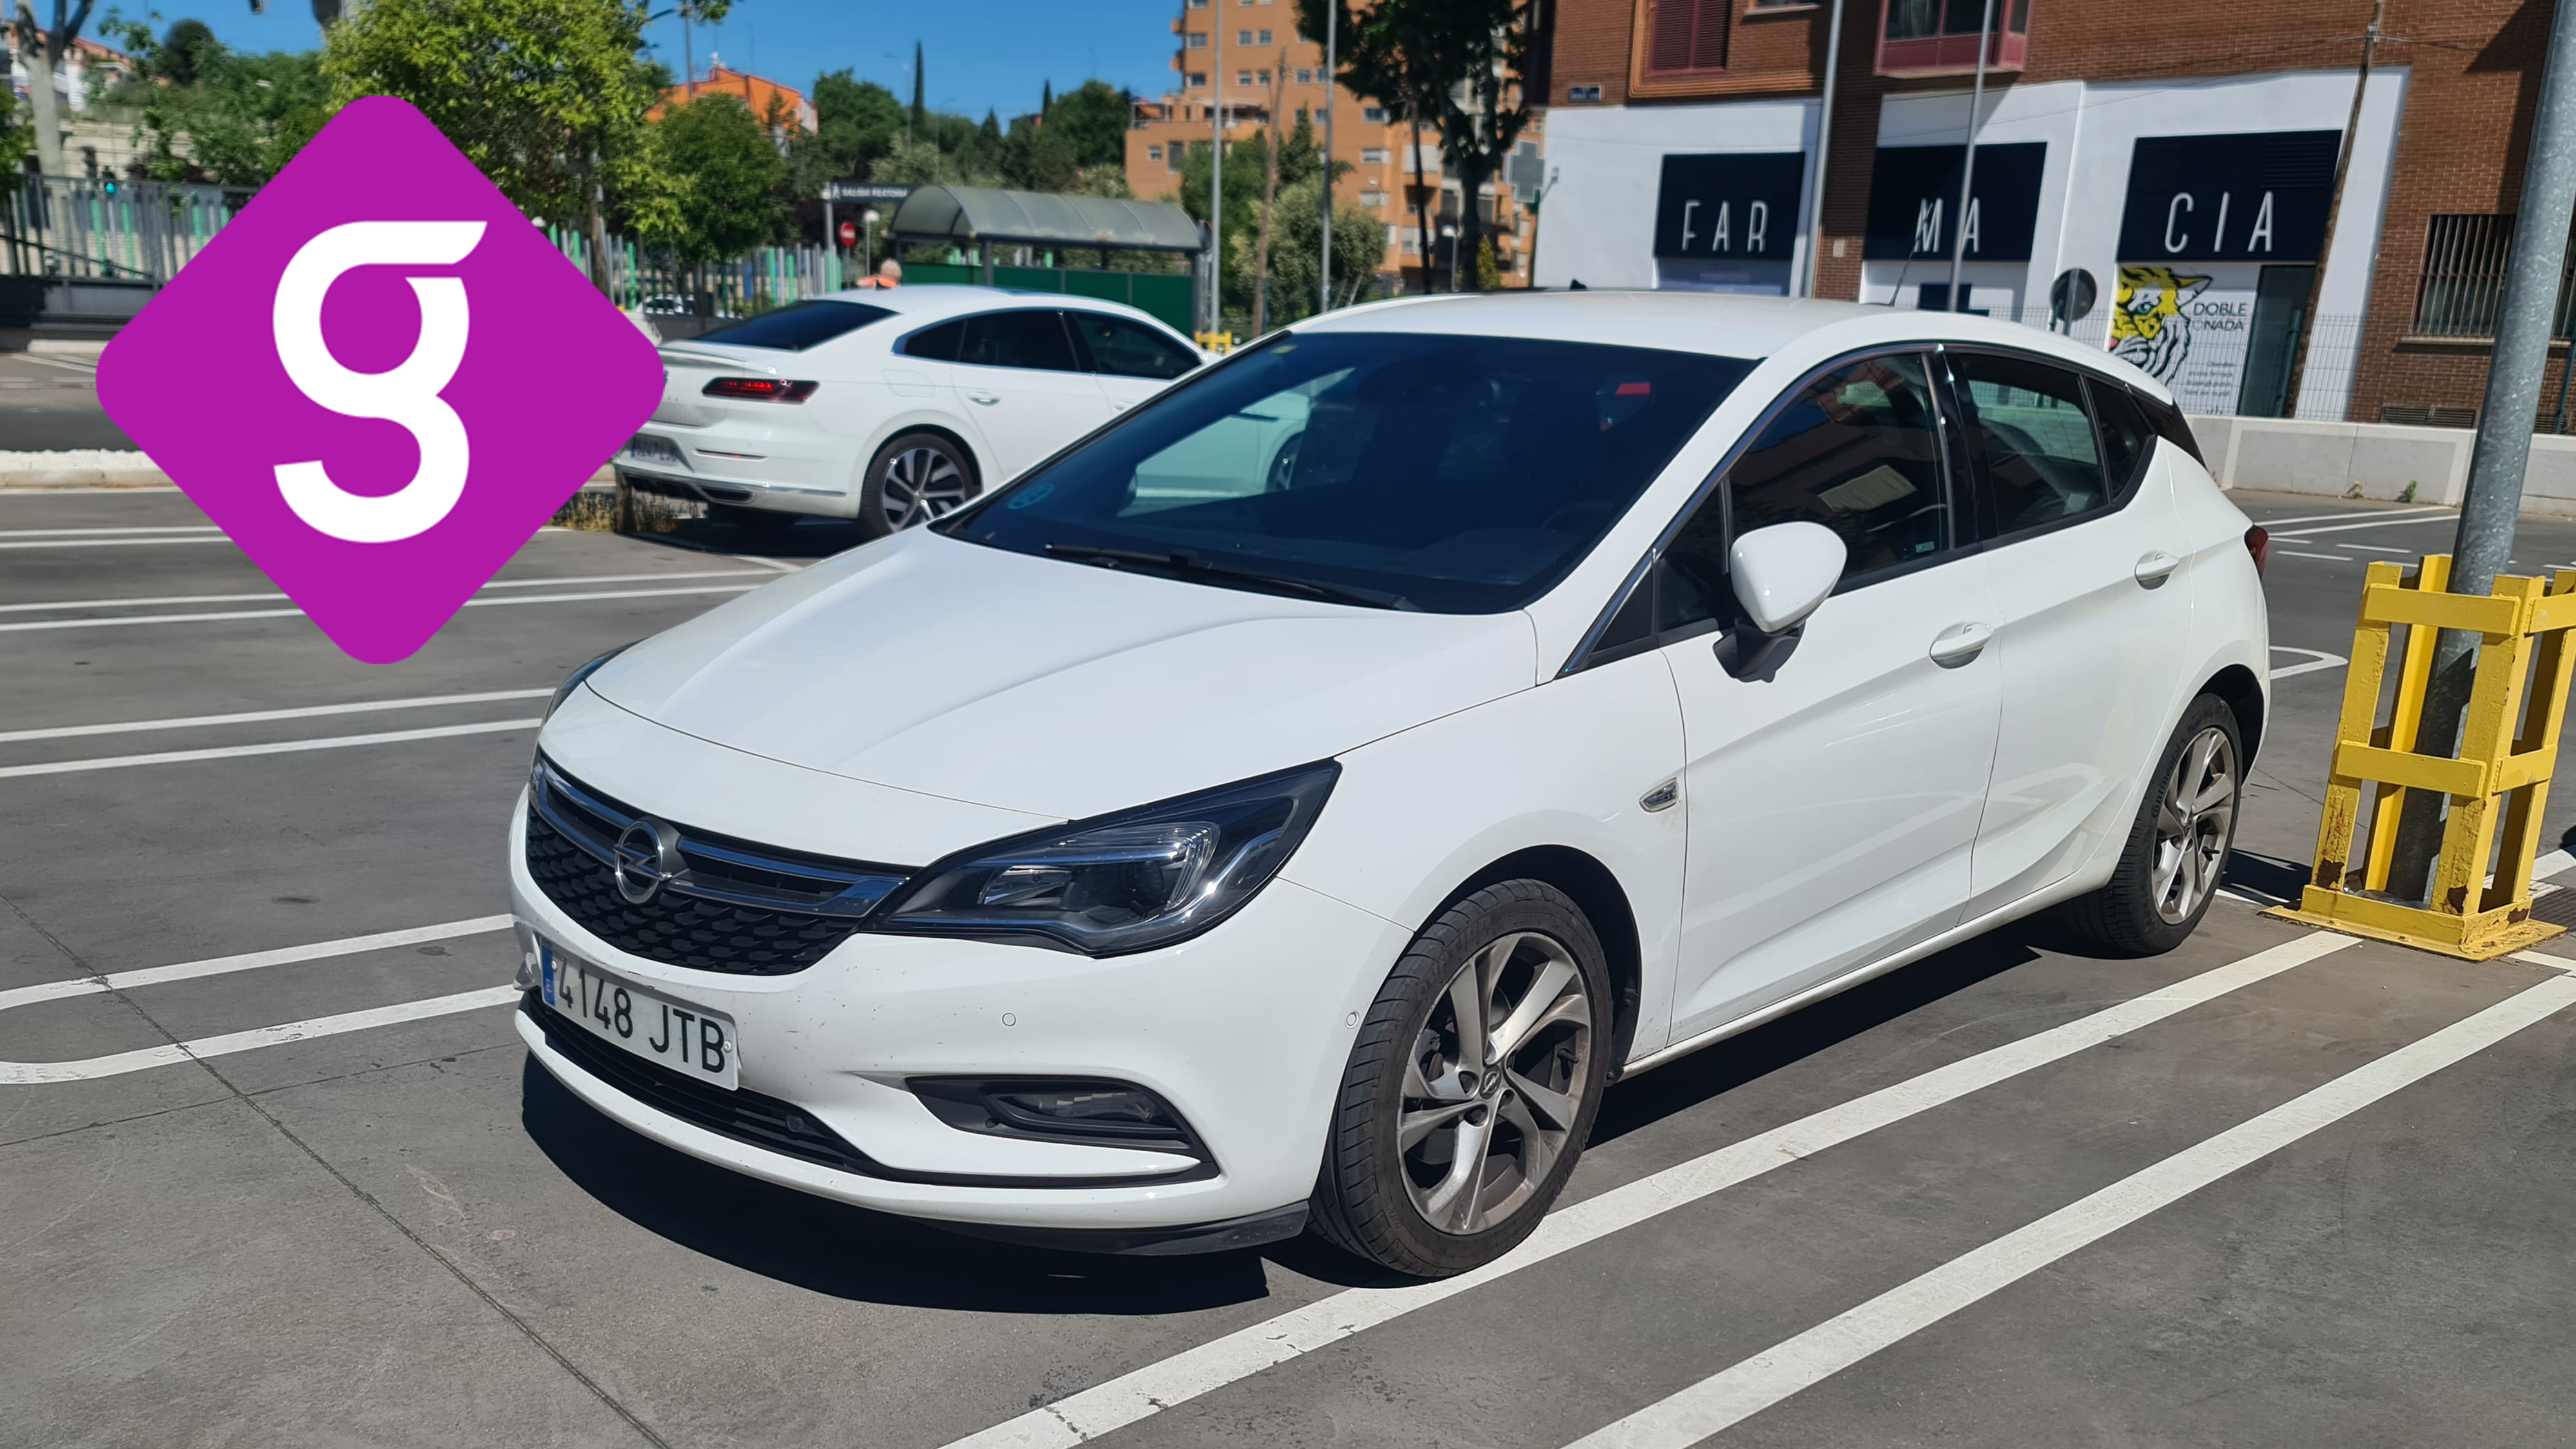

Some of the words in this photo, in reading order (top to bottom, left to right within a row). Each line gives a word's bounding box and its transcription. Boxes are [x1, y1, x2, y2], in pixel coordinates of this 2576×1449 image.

[1682, 200, 1768, 252] FAR
[1914, 197, 1980, 253] MA
[2165, 191, 2274, 253] CIA
[2193, 302, 2249, 316] DOBLE
[558, 957, 634, 1040] 4148
[649, 1003, 727, 1075] JTB
